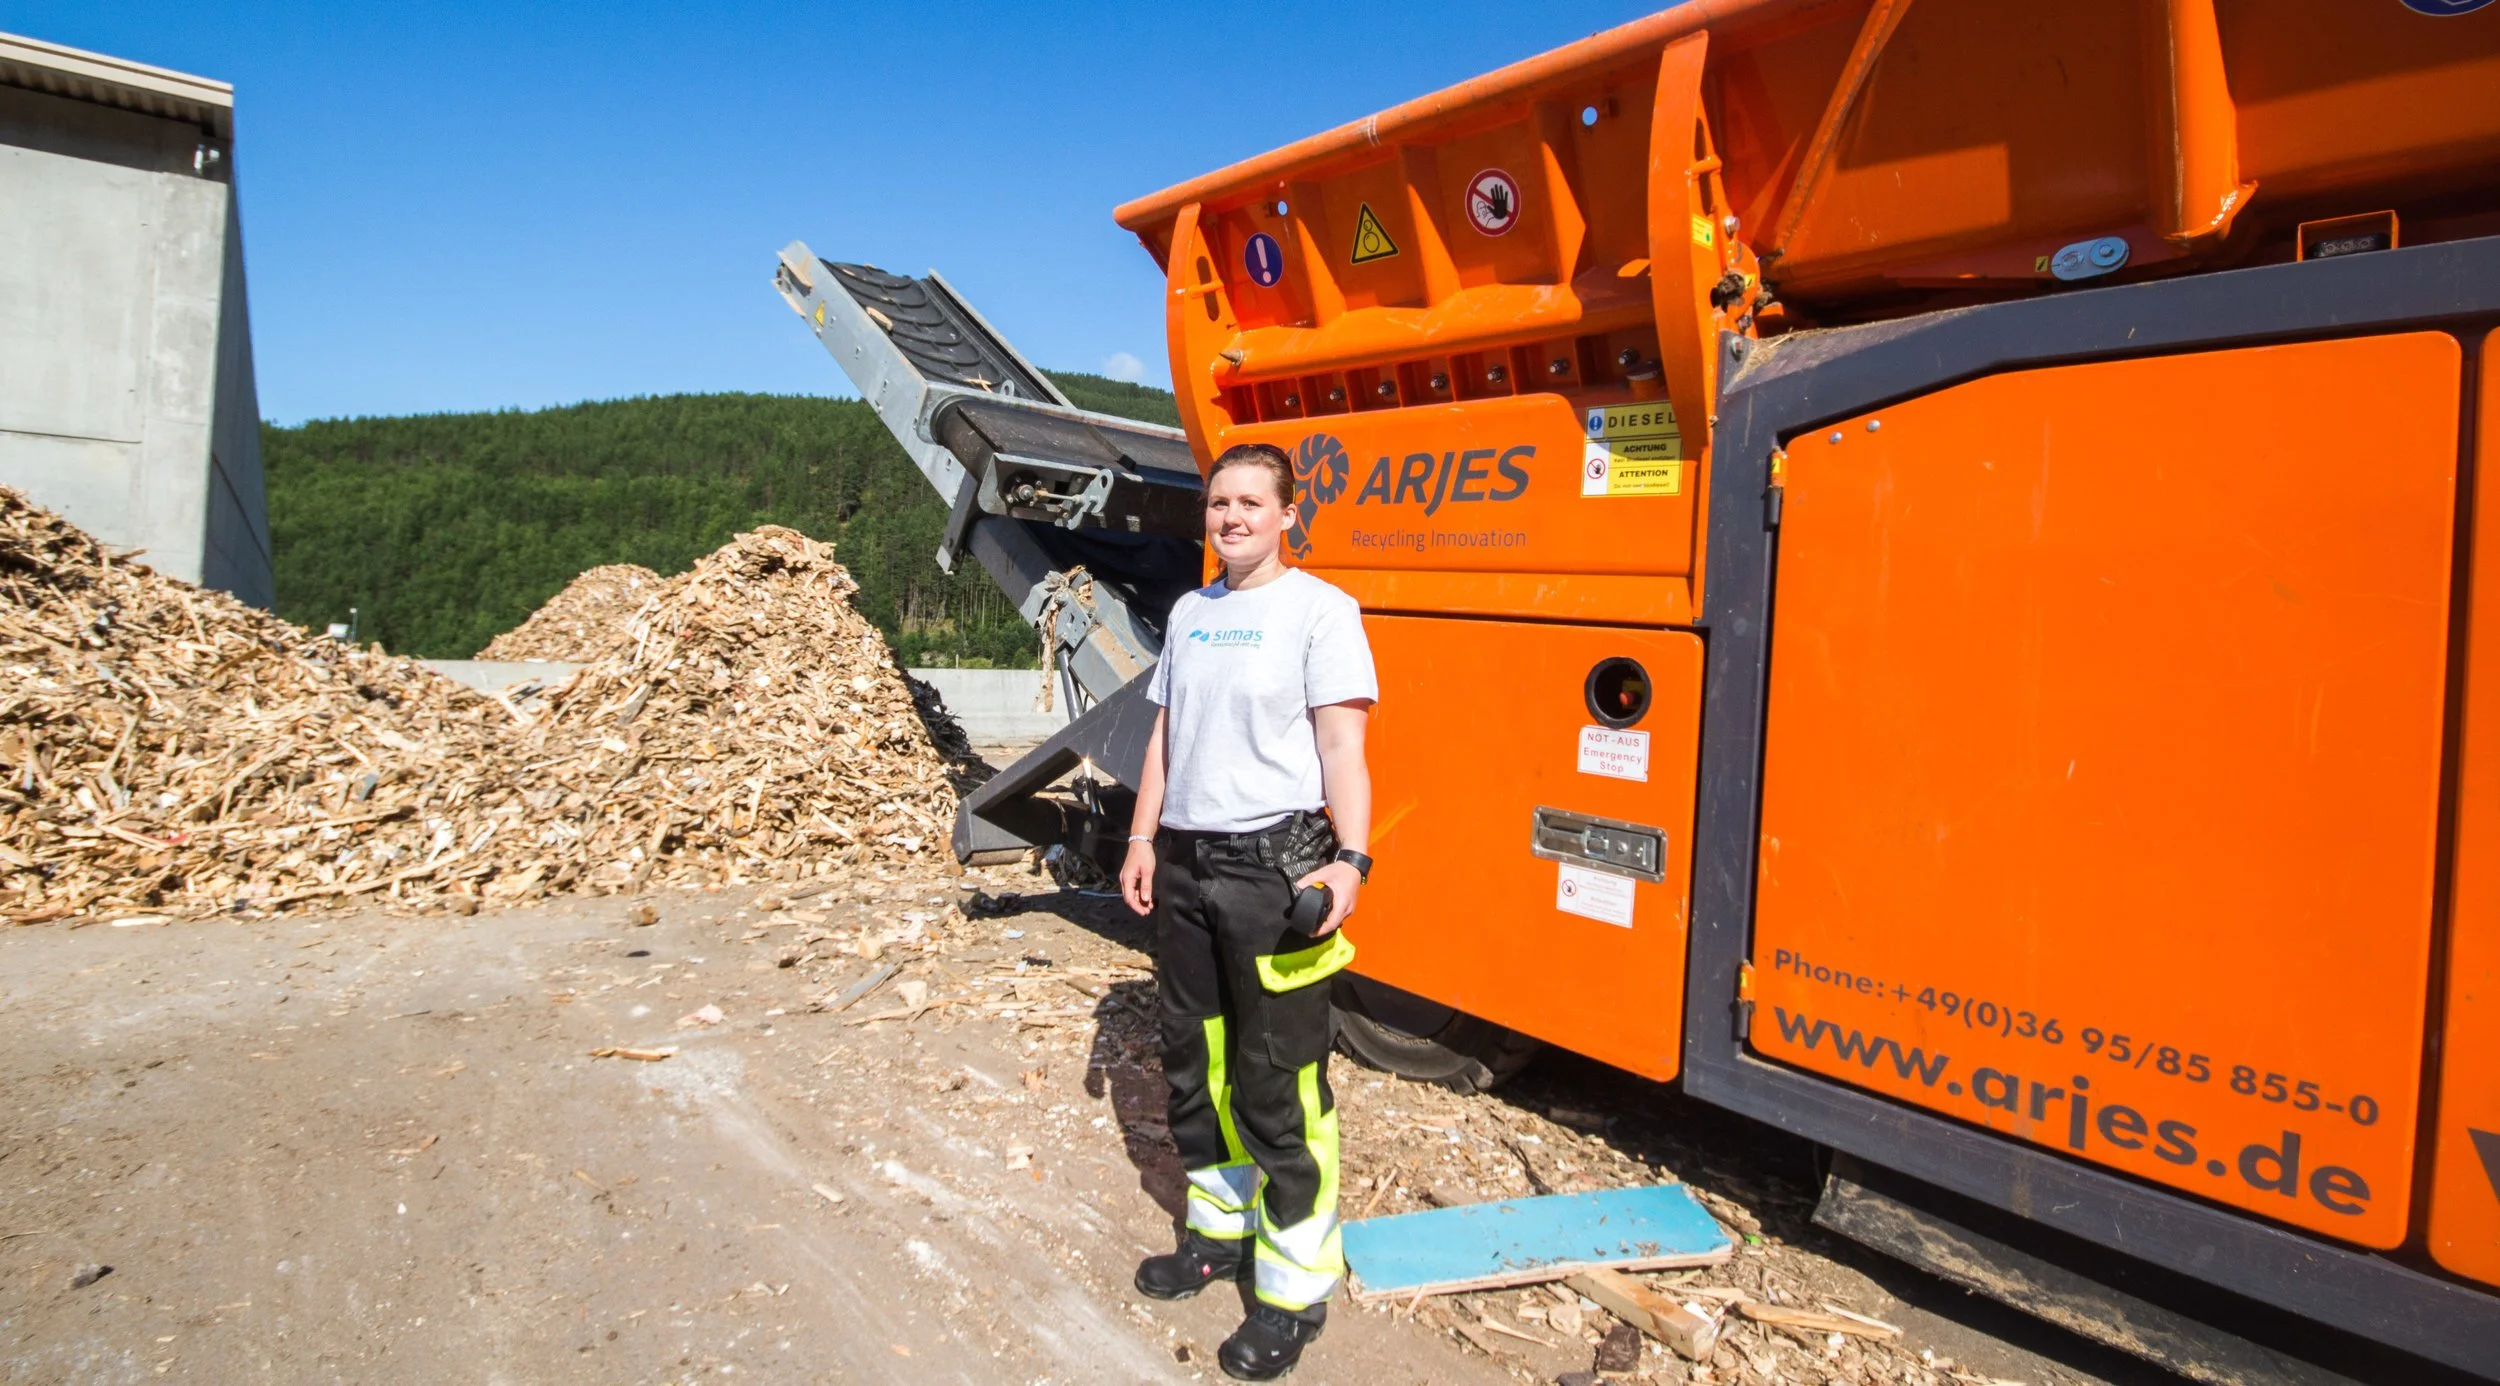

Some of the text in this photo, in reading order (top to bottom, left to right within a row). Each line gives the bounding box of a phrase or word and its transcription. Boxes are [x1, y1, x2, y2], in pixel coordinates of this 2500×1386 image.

[1608, 412, 1676, 428] DIESEL
[1623, 443, 1667, 453] ACHTUNG
[1355, 445, 1537, 518] ARJES
[1618, 469, 1669, 479] ATTENTION
[1352, 528, 1527, 552] Recycling Innovation
[1583, 747, 1643, 765] Emergency
[1600, 760, 1624, 773] Stop
[2079, 1027, 2211, 1083] 95/85
[2229, 1064, 2380, 1127] 855-0
[1773, 1006, 2372, 1217] www.arjes.de
